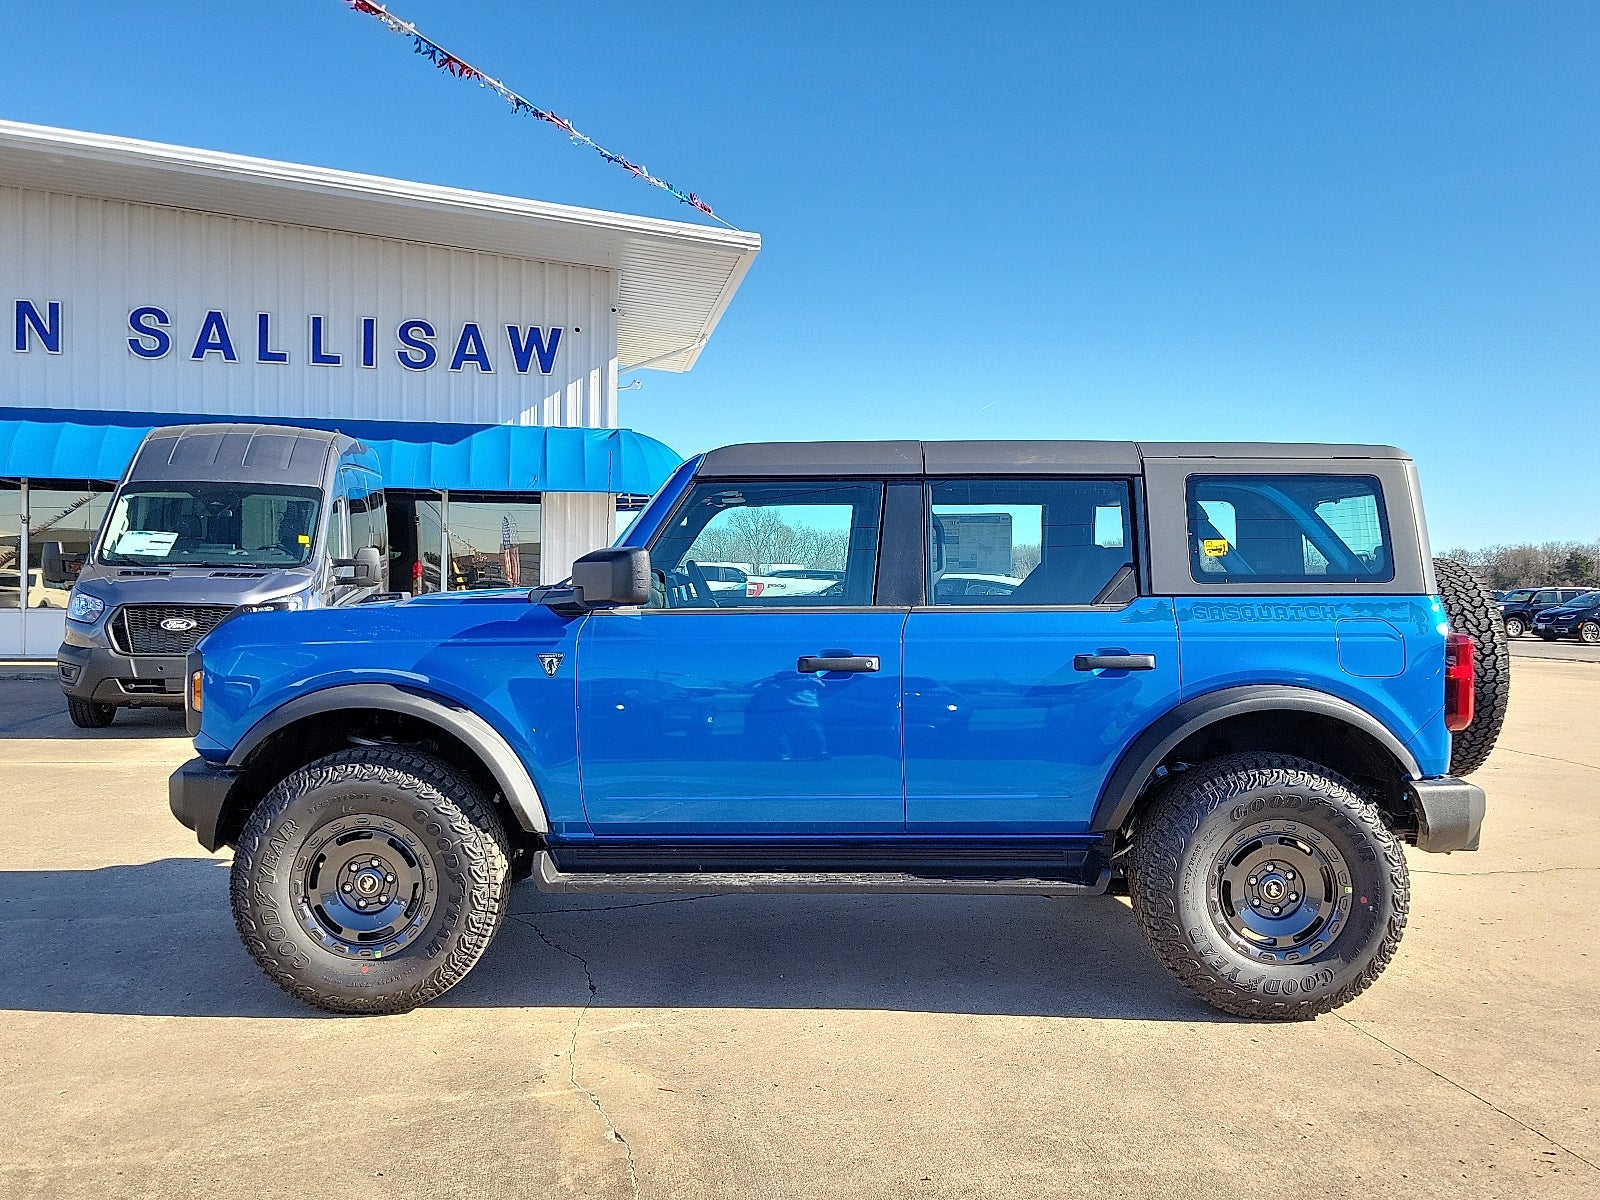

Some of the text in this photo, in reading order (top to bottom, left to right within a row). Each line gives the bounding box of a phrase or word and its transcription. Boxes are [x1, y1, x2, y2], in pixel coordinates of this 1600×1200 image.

[14, 299, 565, 376] N SALLISAW
[1193, 604, 1338, 621] SASQUATCH
[162, 619, 192, 630] Ford
